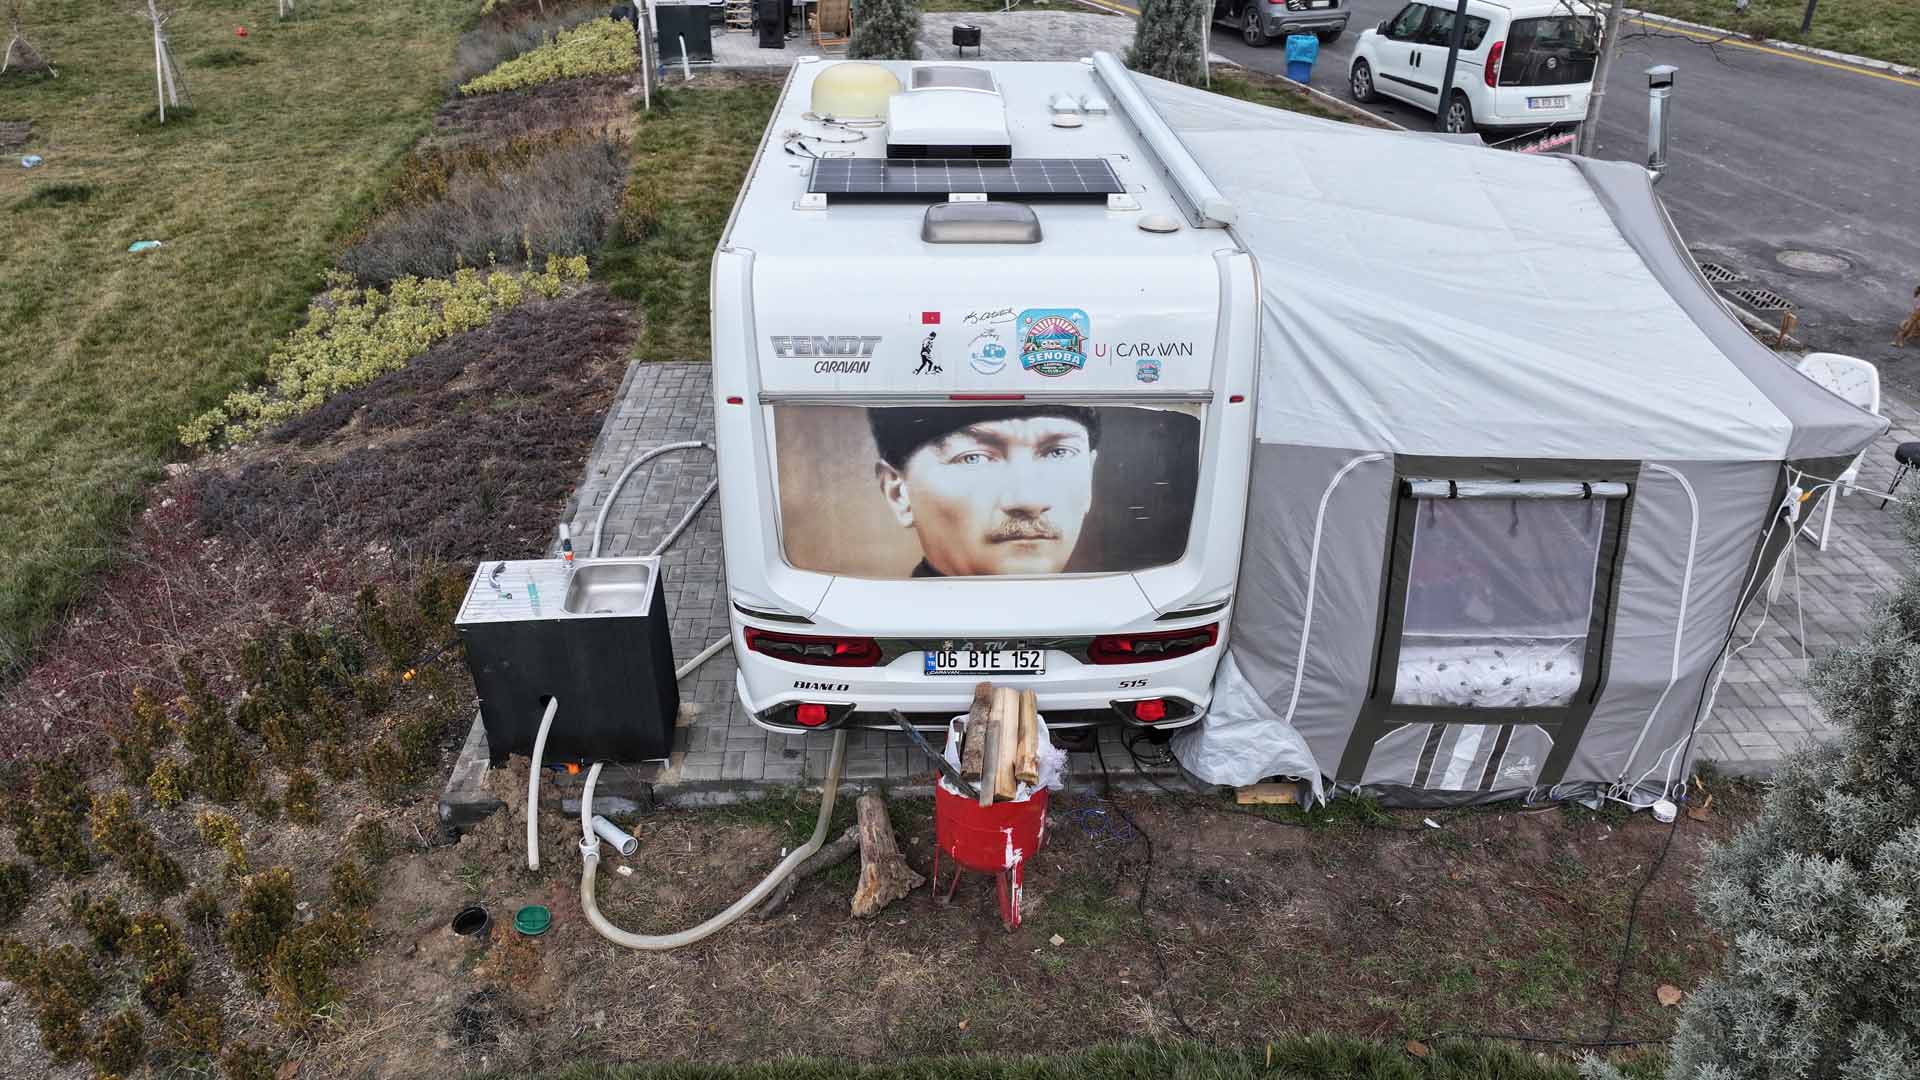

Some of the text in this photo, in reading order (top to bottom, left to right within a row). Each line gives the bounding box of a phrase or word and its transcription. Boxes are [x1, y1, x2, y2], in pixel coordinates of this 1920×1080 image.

[770, 336, 881, 358] FENDT
[1095, 342, 1193, 357] U CARAVAN
[1027, 352, 1081, 364] SENOBA
[814, 361, 870, 373] CARAVAN
[937, 651, 1040, 668] 06 BTE 152
[793, 680, 849, 692] BIANCO
[1118, 678, 1149, 688] 515
